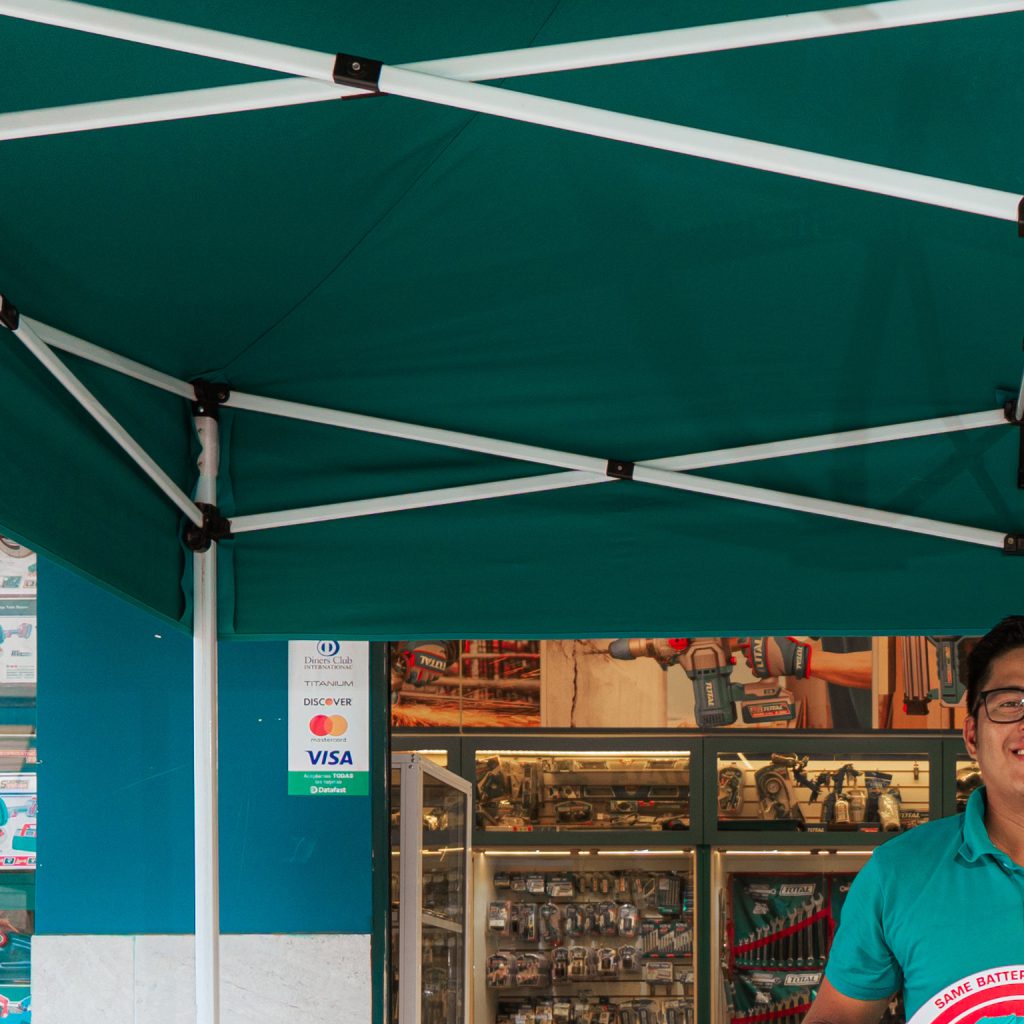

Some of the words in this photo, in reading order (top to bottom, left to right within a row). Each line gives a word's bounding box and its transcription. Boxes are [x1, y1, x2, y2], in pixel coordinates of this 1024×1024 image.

[304, 656, 331, 664] Diners
[333, 656, 353, 664] Club
[304, 698, 352, 706] DISCOVER
[305, 750, 353, 766] VISA
[934, 983, 973, 1010] SAME
